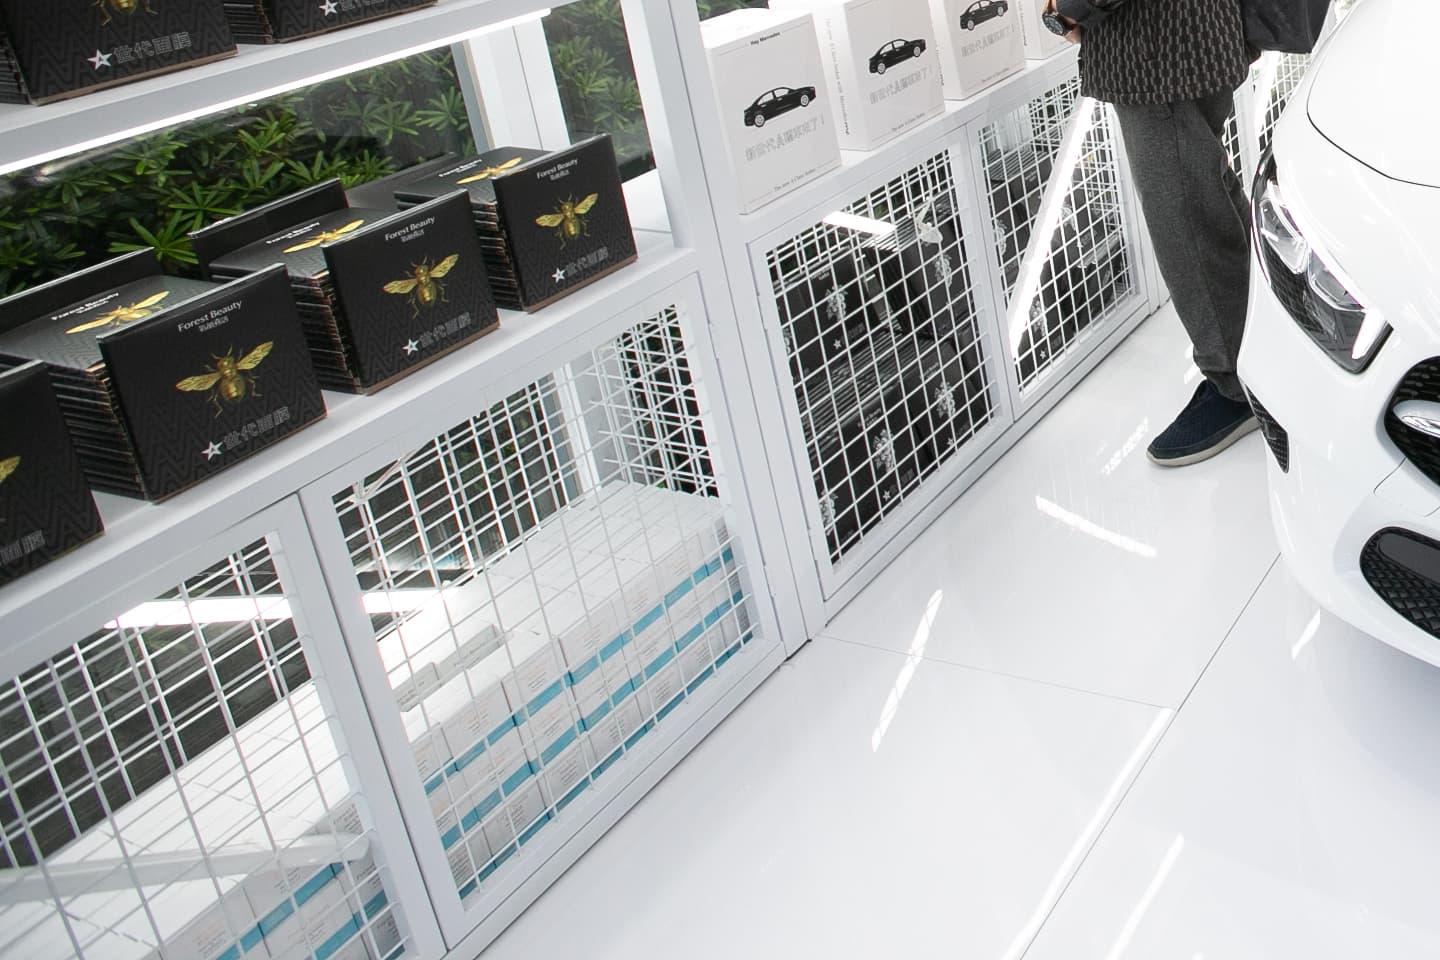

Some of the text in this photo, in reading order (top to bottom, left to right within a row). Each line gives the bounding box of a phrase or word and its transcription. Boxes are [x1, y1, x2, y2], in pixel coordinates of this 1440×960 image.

[536, 166, 557, 180] Forest
[557, 158, 578, 172] Beauty
[384, 226, 409, 242] Forest
[409, 216, 436, 233] Beauty
[177, 312, 209, 333] Forest
[210, 300, 242, 320] Beauty
